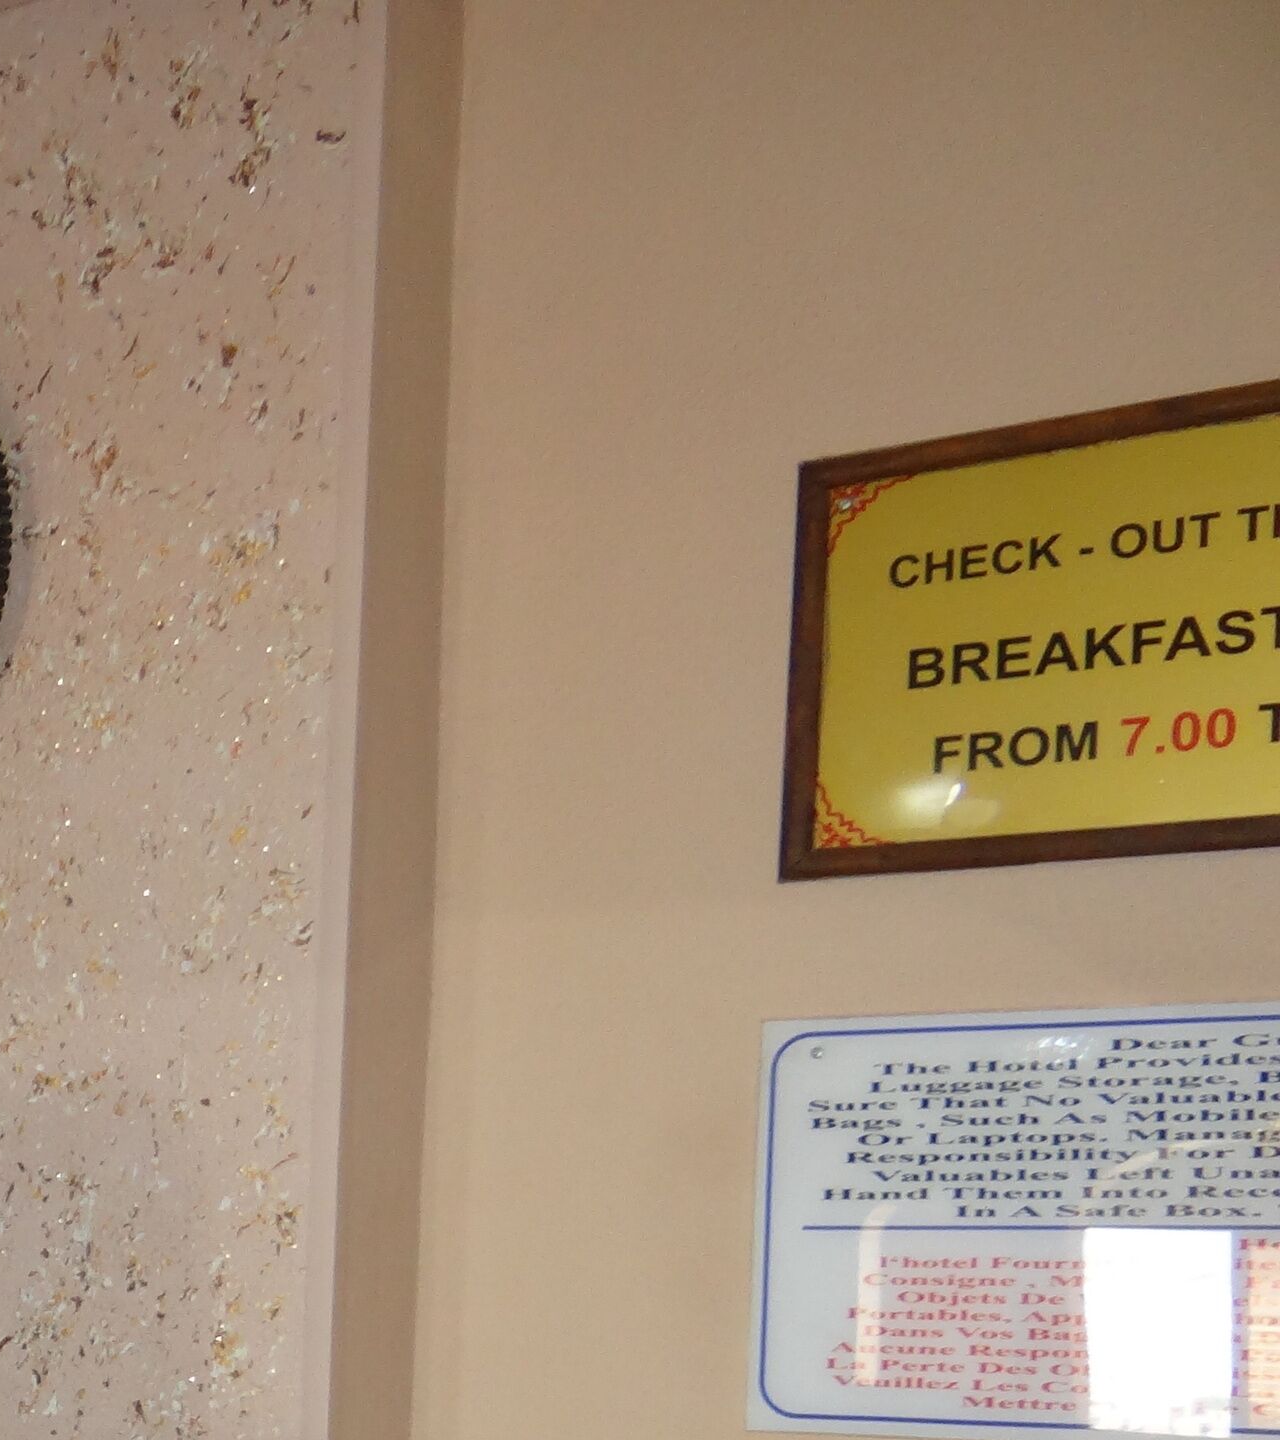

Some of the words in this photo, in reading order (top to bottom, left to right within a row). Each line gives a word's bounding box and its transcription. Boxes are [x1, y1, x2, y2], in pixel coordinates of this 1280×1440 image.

[890, 533, 1062, 589] CHECK
[1110, 512, 1221, 559] OUT
[907, 605, 1280, 690] BREAKFAST
[933, 721, 1098, 775] FROM
[1121, 707, 1237, 757] 7.00
[1110, 1037, 1217, 1051] Dear
[873, 1061, 952, 1075] The
[967, 1058, 1079, 1074] Hotel
[1095, 1052, 1280, 1069] Provides
[868, 1078, 1044, 1095] Luggage
[807, 1099, 898, 1112] Sure
[909, 1096, 1008, 1110] That
[1021, 1093, 1081, 1107] No
[810, 1117, 903, 1131] Bags
[940, 1113, 1040, 1127] Such
[1053, 1111, 1107, 1125] As
[1125, 1108, 1280, 1123] Mobile
[856, 1133, 914, 1146] Or
[1127, 1127, 1280, 1143] Manag
[845, 1147, 1139, 1166] Responsibility
[1157, 1146, 1236, 1160] For
[872, 1168, 1069, 1183] Valuables
[1087, 1166, 1175, 1181] Left
[1193, 1165, 1280, 1180] Una
[821, 1187, 929, 1201] Hand
[942, 1187, 1062, 1200] Them
[1083, 1185, 1169, 1199] Into
[955, 1204, 997, 1218] In
[1008, 1205, 1042, 1218] A
[1055, 1204, 1148, 1218] Safe
[990, 1256, 1086, 1270] Fourn
[862, 1272, 1017, 1290] Consigne
[897, 1290, 1008, 1307] Objets
[1019, 1292, 1066, 1305] De
[864, 1325, 945, 1338] Dans
[956, 1327, 1015, 1340] Vos
[831, 1342, 956, 1356] Aucune
[968, 1344, 1088, 1361] Respon
[824, 1358, 866, 1370] La
[880, 1358, 966, 1373] Perte
[978, 1362, 1039, 1375] Des
[833, 1375, 960, 1391] Veuillez
[972, 1379, 1030, 1393] Les
[962, 1396, 1078, 1411] Mettre
